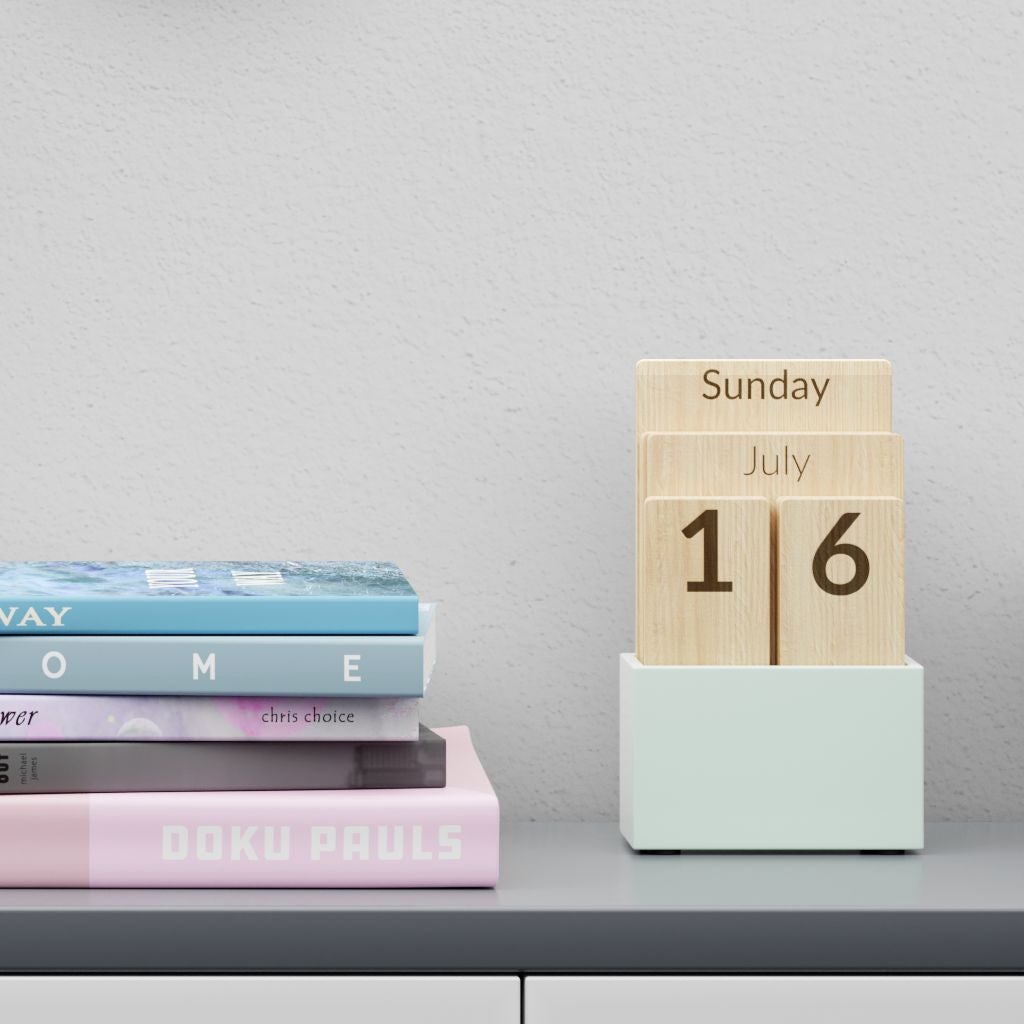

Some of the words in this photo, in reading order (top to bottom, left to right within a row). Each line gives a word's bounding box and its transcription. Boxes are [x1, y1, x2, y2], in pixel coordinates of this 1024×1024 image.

[701, 368, 831, 407] Sunday
[743, 444, 812, 483] July
[681, 508, 733, 593] 1
[811, 512, 871, 597] 6
[260, 705, 299, 724] chris
[303, 706, 356, 724] choice
[19, 752, 28, 785] michael
[30, 756, 40, 781] james
[161, 824, 292, 862] DOKU
[310, 823, 463, 862] PAULS
